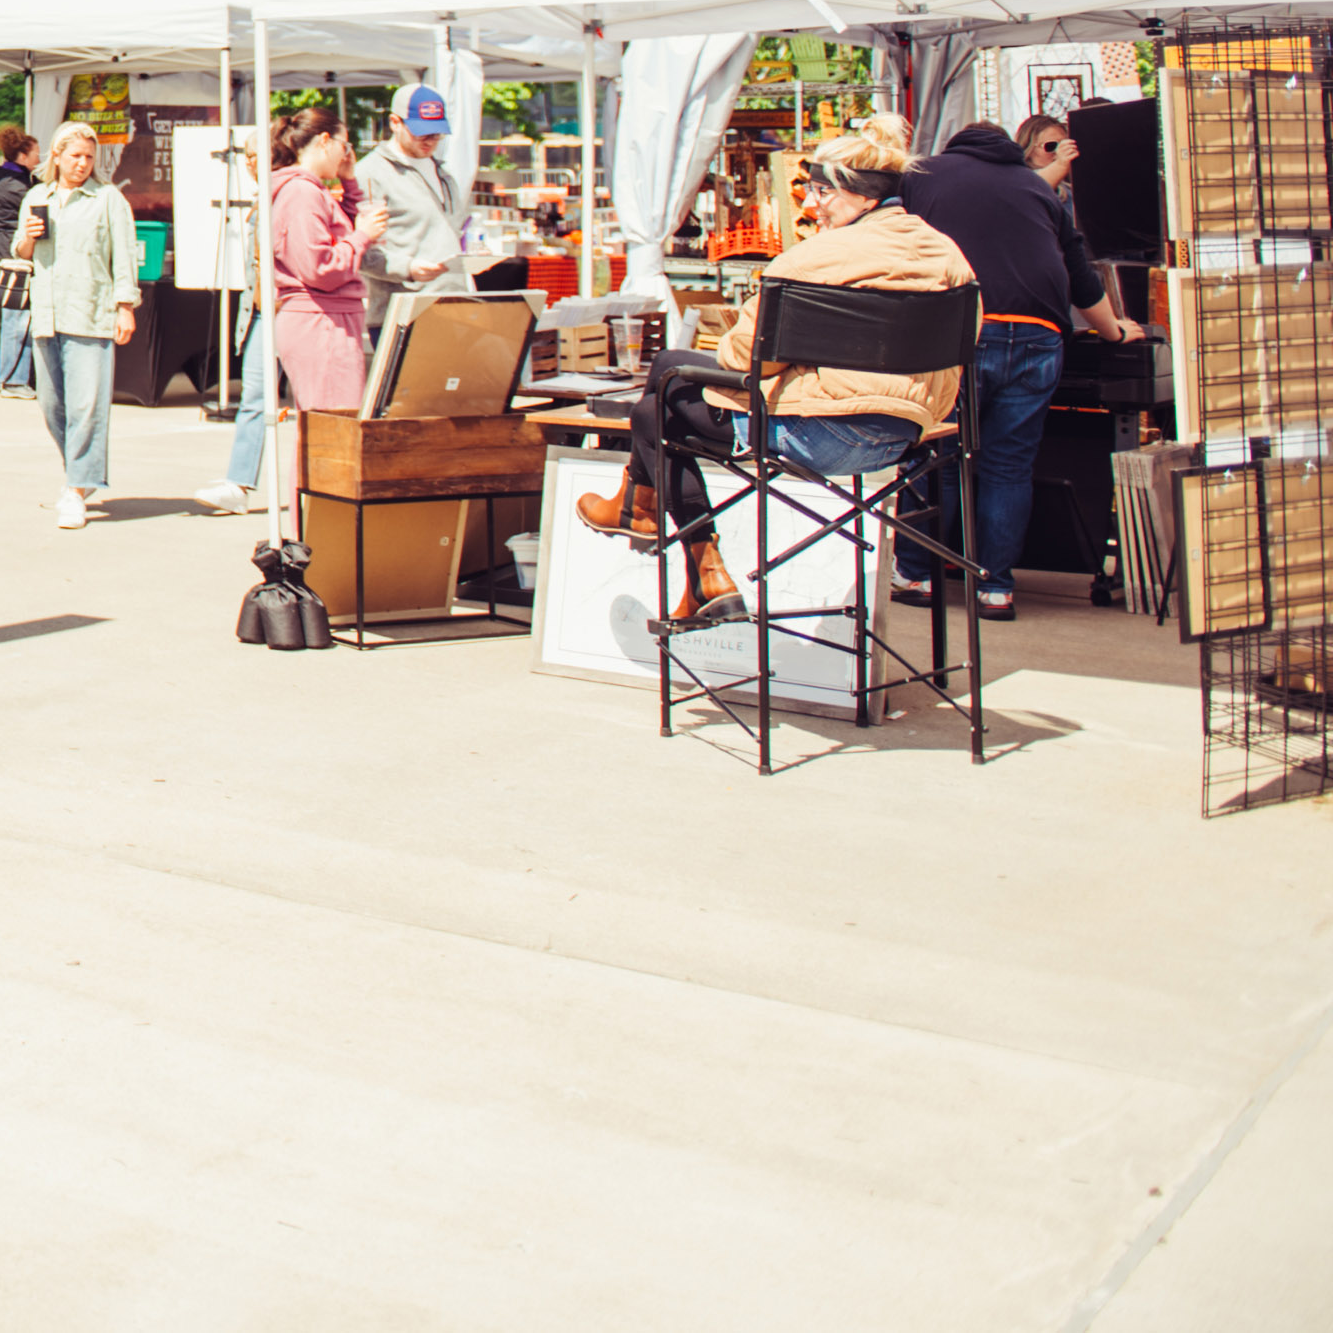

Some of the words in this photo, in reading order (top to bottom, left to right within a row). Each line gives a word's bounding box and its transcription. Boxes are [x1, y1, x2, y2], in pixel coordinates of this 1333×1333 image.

[153, 120, 172, 133] GET
[154, 136, 172, 149] WI
[153, 151, 171, 165] FE
[153, 168, 171, 182] DI
[672, 634, 744, 651] ASHVILLE
